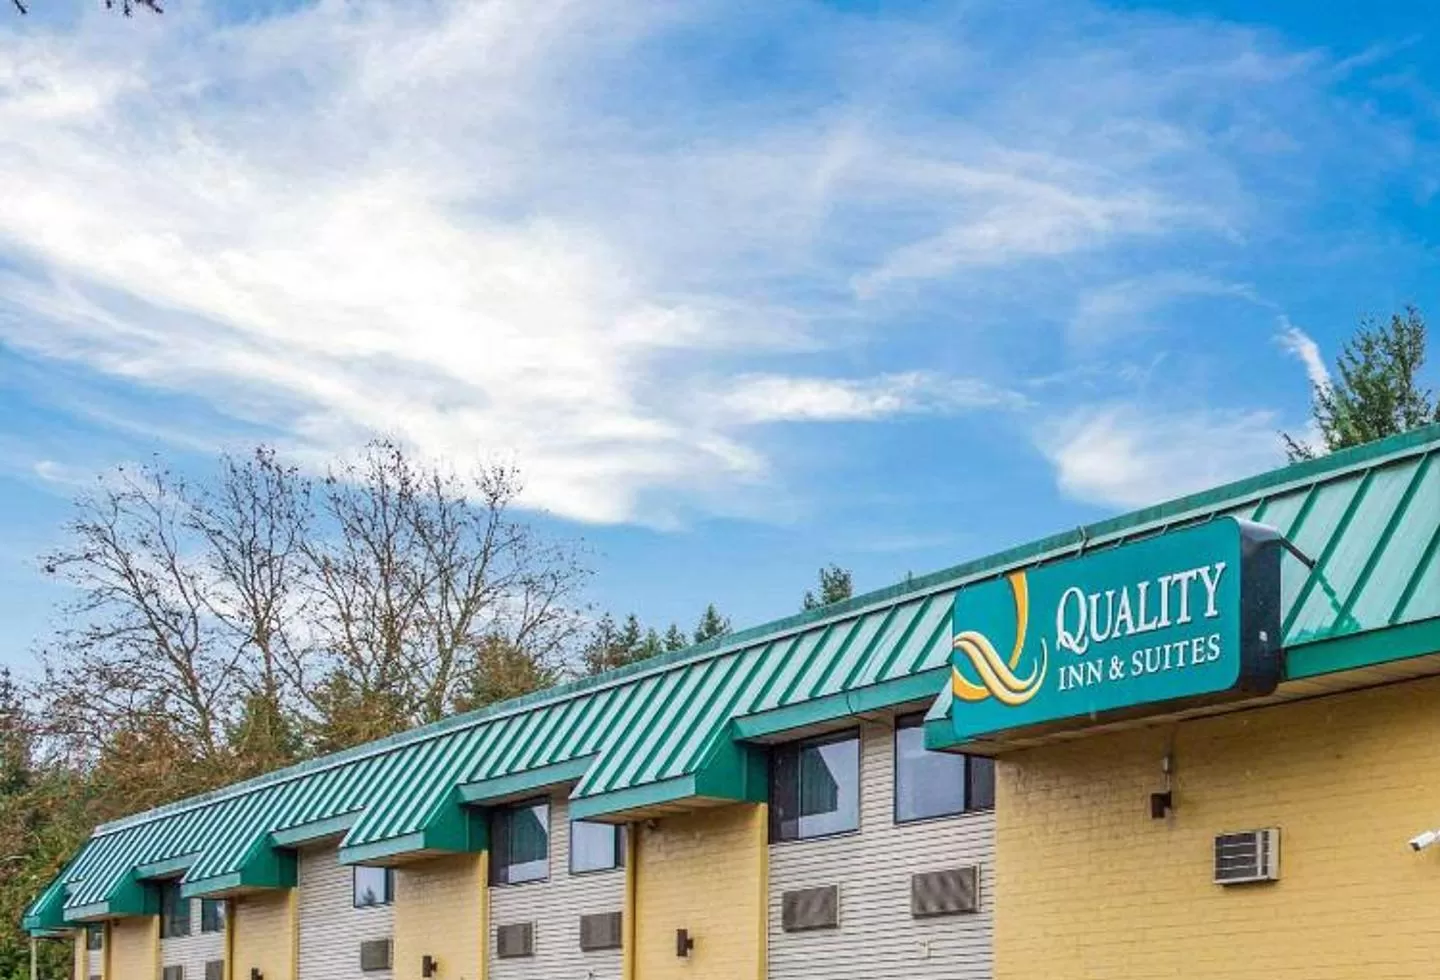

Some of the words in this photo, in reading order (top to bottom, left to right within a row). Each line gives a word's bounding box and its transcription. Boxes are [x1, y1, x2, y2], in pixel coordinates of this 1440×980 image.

[1056, 562, 1226, 654] QUALITY
[1059, 659, 1104, 691] INN
[1109, 655, 1125, 681] &
[1131, 633, 1221, 676] SUITES
